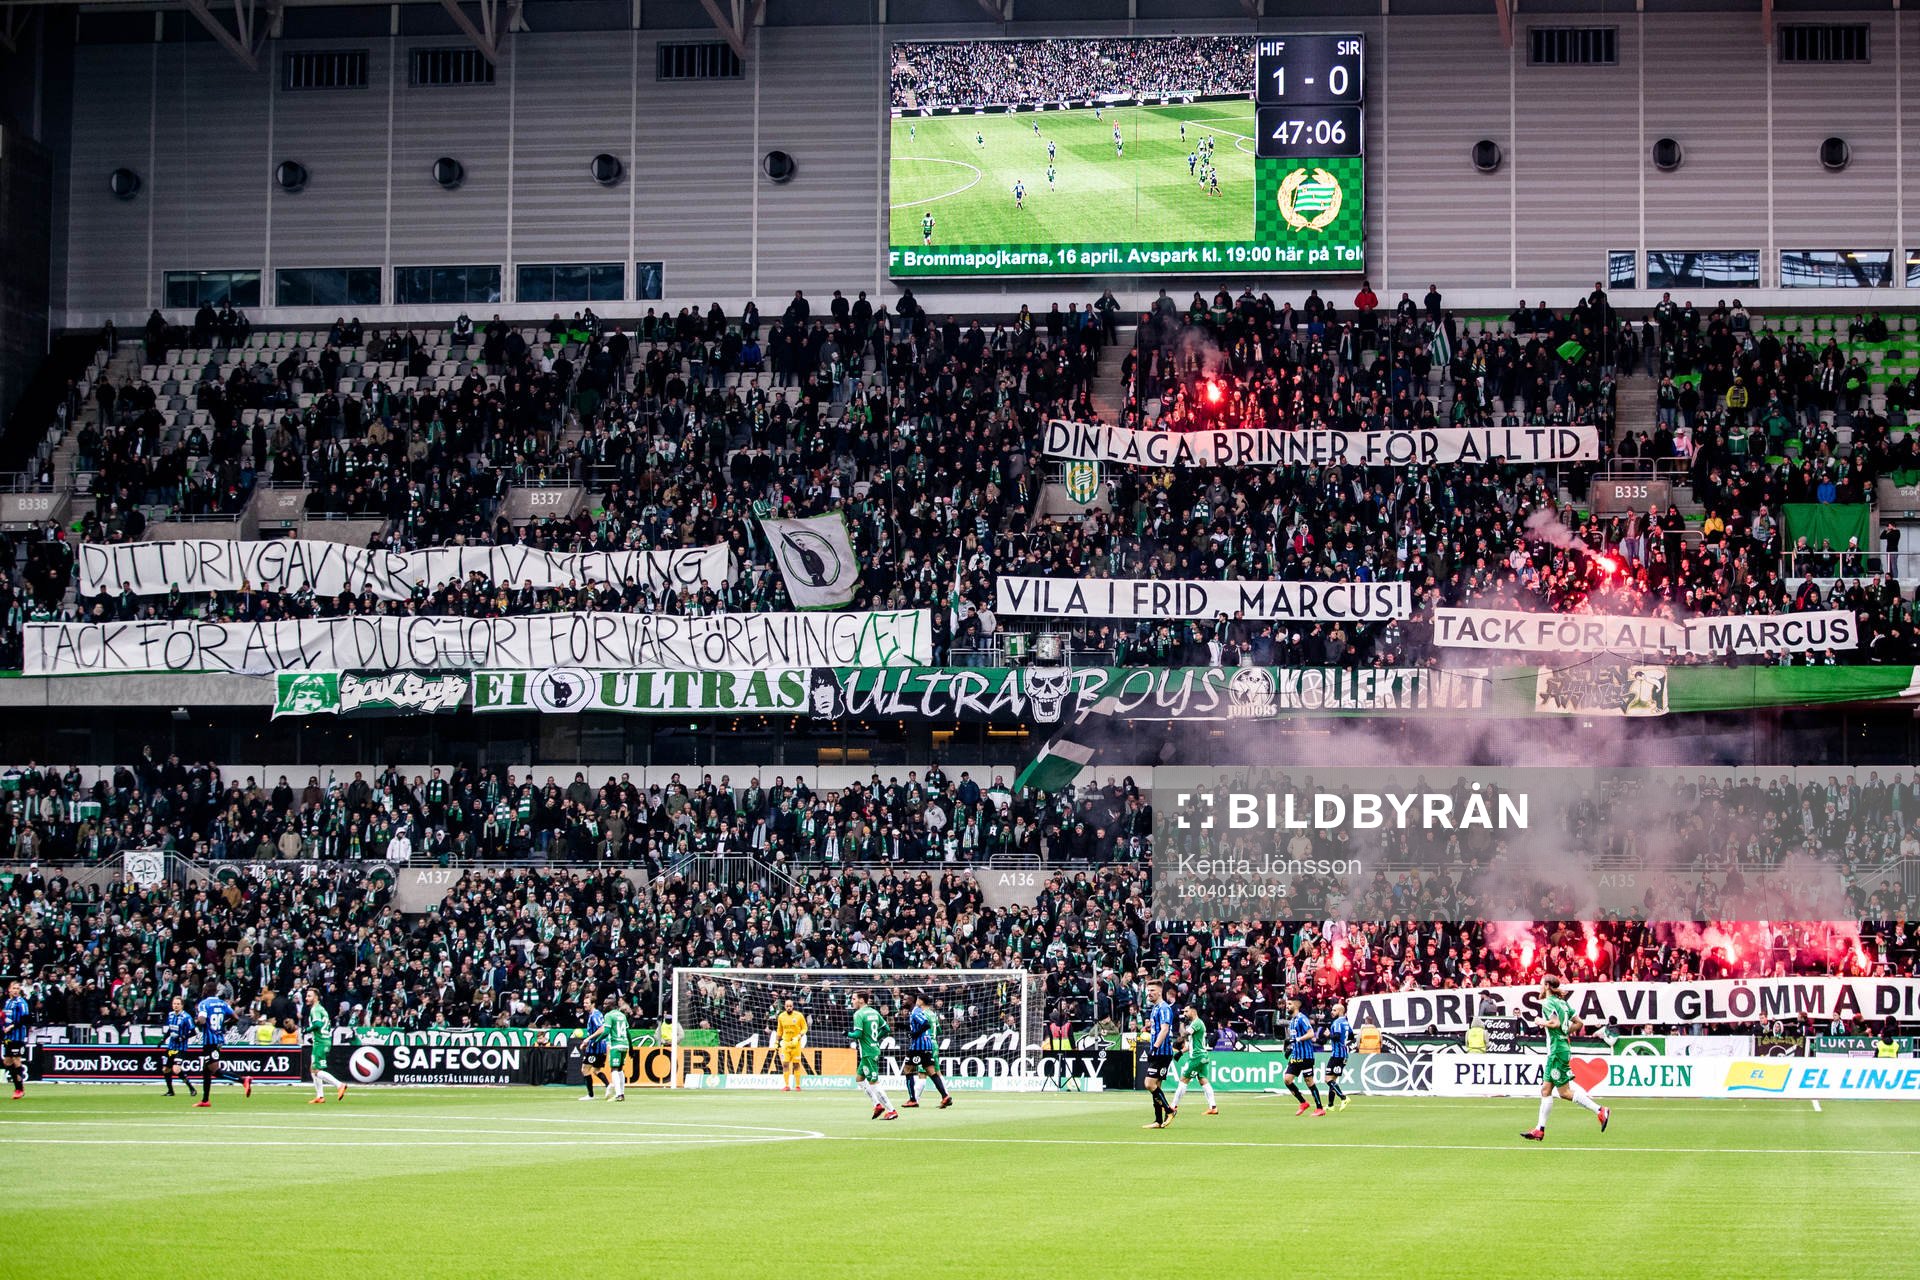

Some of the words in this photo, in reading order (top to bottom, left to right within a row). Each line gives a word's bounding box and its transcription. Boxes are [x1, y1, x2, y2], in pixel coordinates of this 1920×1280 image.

[1260, 41, 1285, 57] HIF
[1337, 41, 1360, 56] SIR
[1273, 67, 1285, 95] 1
[1329, 66, 1349, 95] 0
[1273, 120, 1346, 145] 47:06
[889, 252, 899, 266] F
[904, 250, 1053, 269] Brommapojkarna,
[1057, 249, 1077, 264] 16
[1081, 248, 1123, 267] april.
[1127, 248, 1198, 266] Avspark
[1202, 248, 1222, 263] kl.
[1227, 247, 1271, 262] 19:00
[1276, 247, 1303, 262] här
[1309, 246, 1329, 264] på
[1048, 421, 1101, 459] DIN
[1213, 431, 1348, 464] BRINNER
[1366, 429, 1438, 463] FÖR
[1458, 428, 1590, 461] ALLTID.
[531, 492, 562, 506] B337
[1614, 485, 1648, 499] B335
[18, 498, 49, 511] B338
[83, 541, 176, 589] DITT
[182, 538, 258, 584] DRIV
[256, 541, 332, 589] GAV
[544, 550, 708, 592] MENING
[1003, 578, 1089, 615] VILA
[1107, 582, 1116, 615] I
[1133, 582, 1221, 618] FRID,
[1239, 584, 1403, 618] MARCUS!
[26, 623, 130, 671] TACK
[136, 620, 234, 670] FÖR
[242, 617, 348, 670] ALLT
[353, 616, 401, 669] DU
[407, 616, 547, 668] GJORT
[549, 611, 628, 664] FÖR
[622, 615, 687, 668] VÅR
[1437, 616, 1526, 646] TACK
[1537, 616, 1601, 647] FÖR
[1615, 624, 1697, 651] ALLT
[1708, 618, 1850, 650] MARCUS
[600, 670, 805, 709] ULTRAS
[844, 668, 1026, 717] ULTRA
[416, 871, 452, 885] A137
[998, 873, 1035, 886] A136
[1599, 873, 1636, 888] A135
[1619, 989, 1658, 1020] VI
[1875, 984, 1920, 1017] DI
[870, 1021, 879, 1041] 8
[1819, 1037, 1866, 1049] LUKTA
[143, 1056, 158, 1072] &
[264, 1055, 290, 1073] AB
[394, 1073, 495, 1084] BYGGNADSSTÄLLNINGAR
[499, 1075, 510, 1084] AB
[801, 1077, 851, 1089] KVARNEN
[1609, 1064, 1693, 1088] BAJEN
[1799, 1067, 1832, 1090] EL
